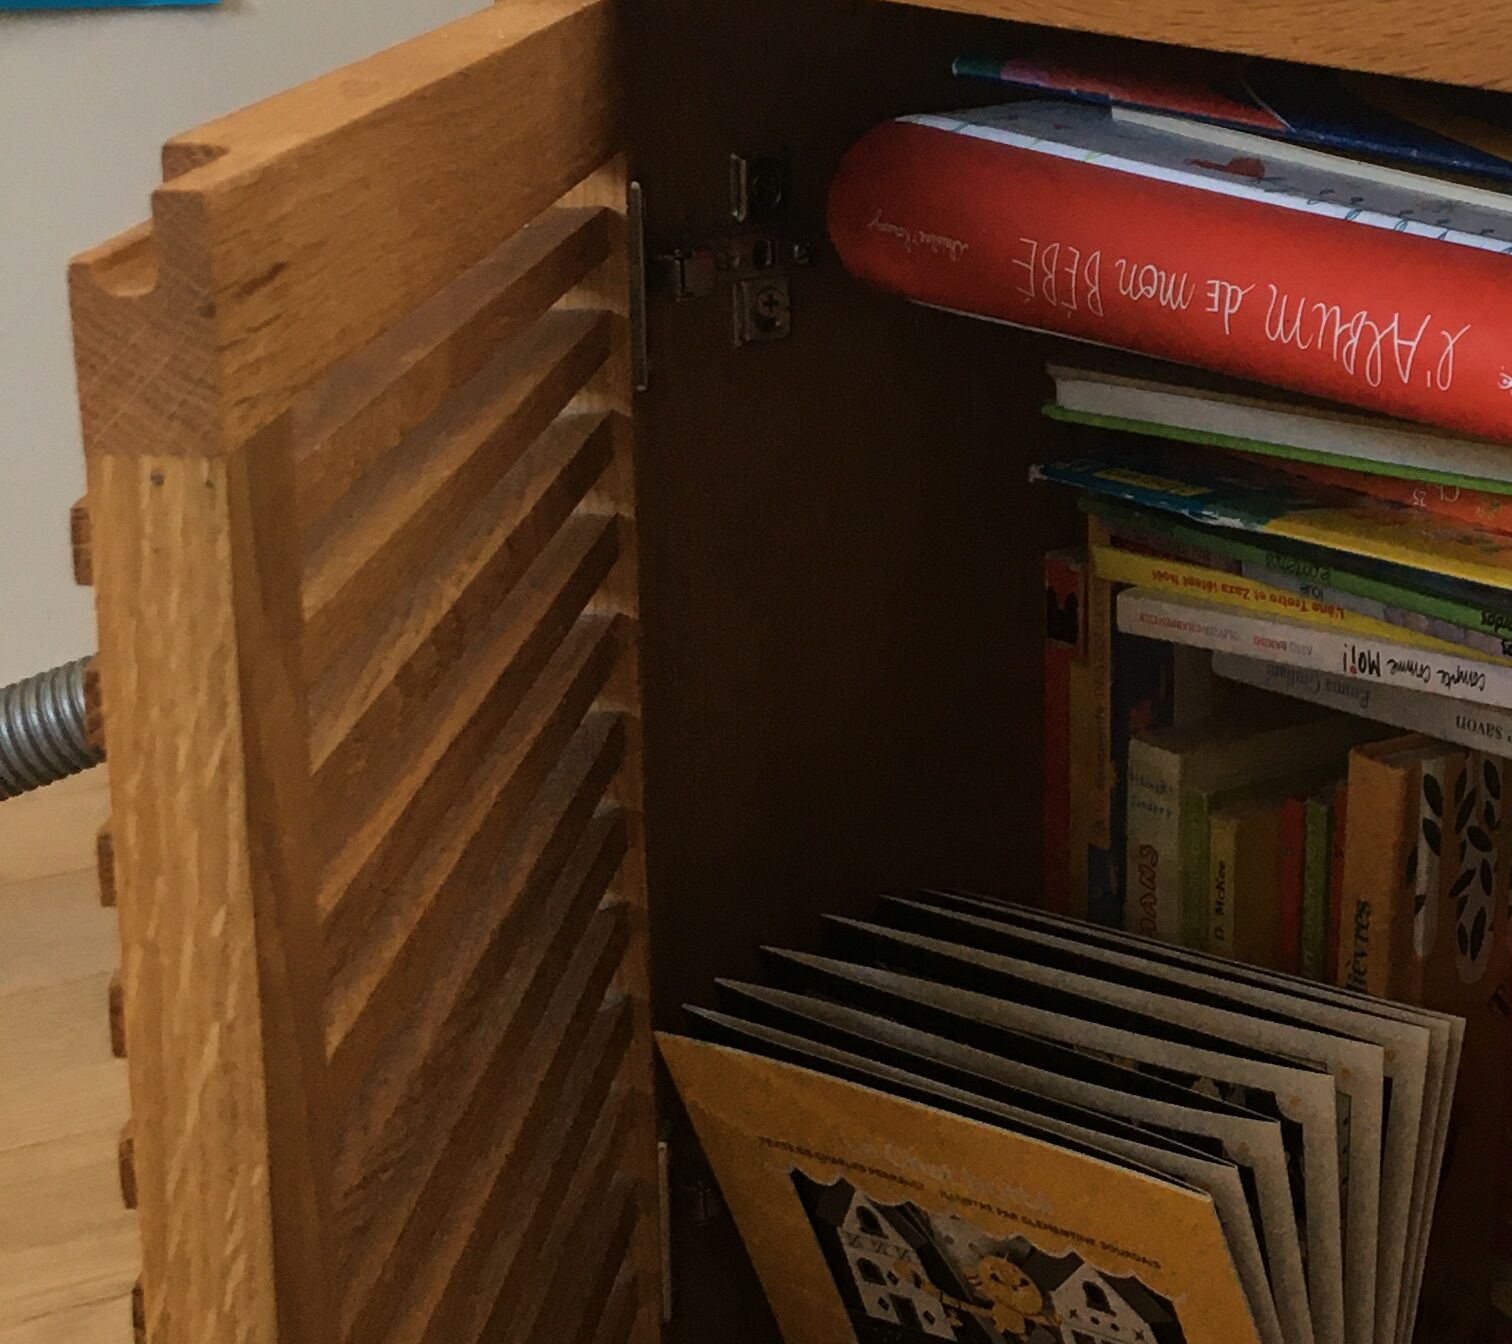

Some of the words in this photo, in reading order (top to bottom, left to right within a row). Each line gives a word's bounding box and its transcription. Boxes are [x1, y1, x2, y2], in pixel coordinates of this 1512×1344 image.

[1011, 237, 1103, 317] BÉBÉ
[1117, 257, 1196, 312] mon
[1221, 583, 1251, 602] Zaza
[1254, 588, 1267, 603] et
[1270, 592, 1309, 613] Trotro
[1324, 677, 1371, 710] Emma
[1454, 714, 1504, 742] savon
[1213, 858, 1227, 916] McKee
